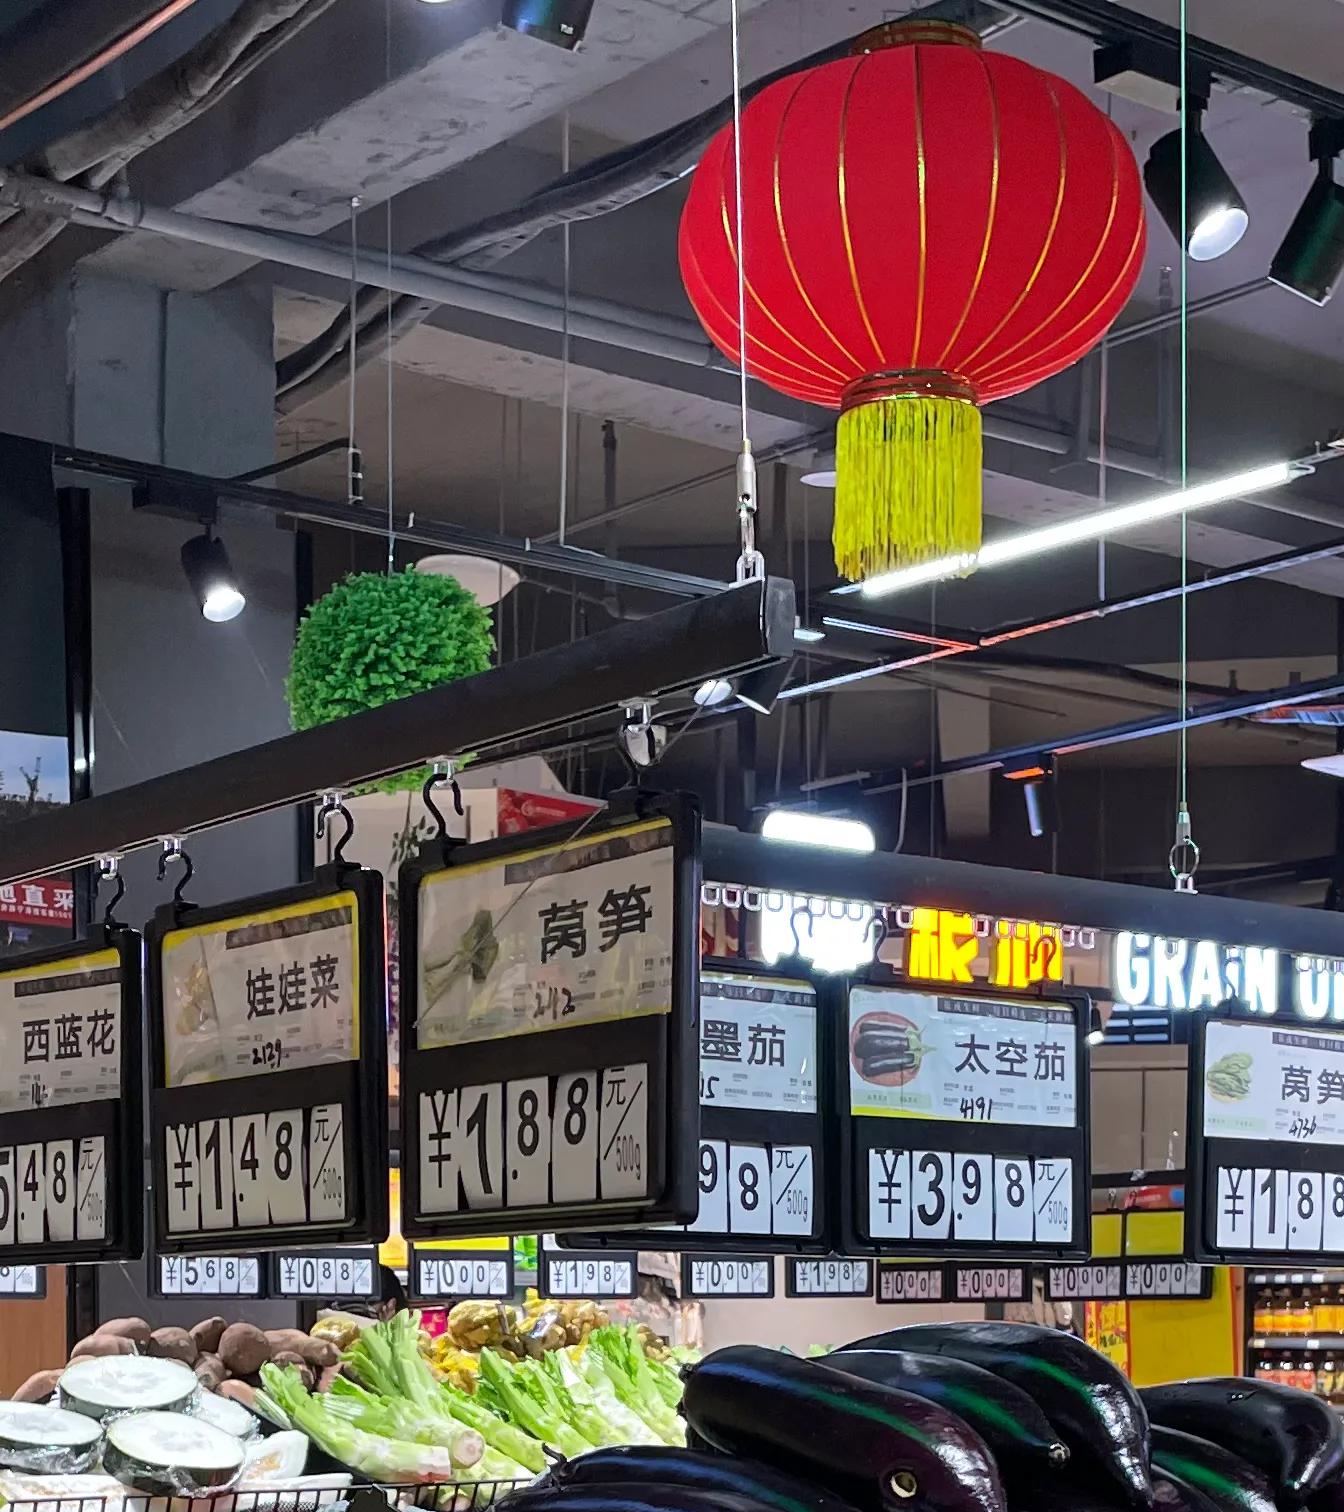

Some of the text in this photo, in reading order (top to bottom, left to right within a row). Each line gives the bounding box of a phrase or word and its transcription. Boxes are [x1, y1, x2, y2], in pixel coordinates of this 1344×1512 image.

[538, 884, 653, 964] 莴笋
[246, 954, 340, 1020] 娃娃菜
[22, 1009, 115, 1064] 西蓝花
[700, 1019, 786, 1068] 墨茄
[955, 1033, 1066, 1081] 太空茄
[174, 1121, 293, 1210] ¥1.48
[428, 1076, 589, 1194] ¥1.88
[875, 1149, 1024, 1226] ¥3.98
